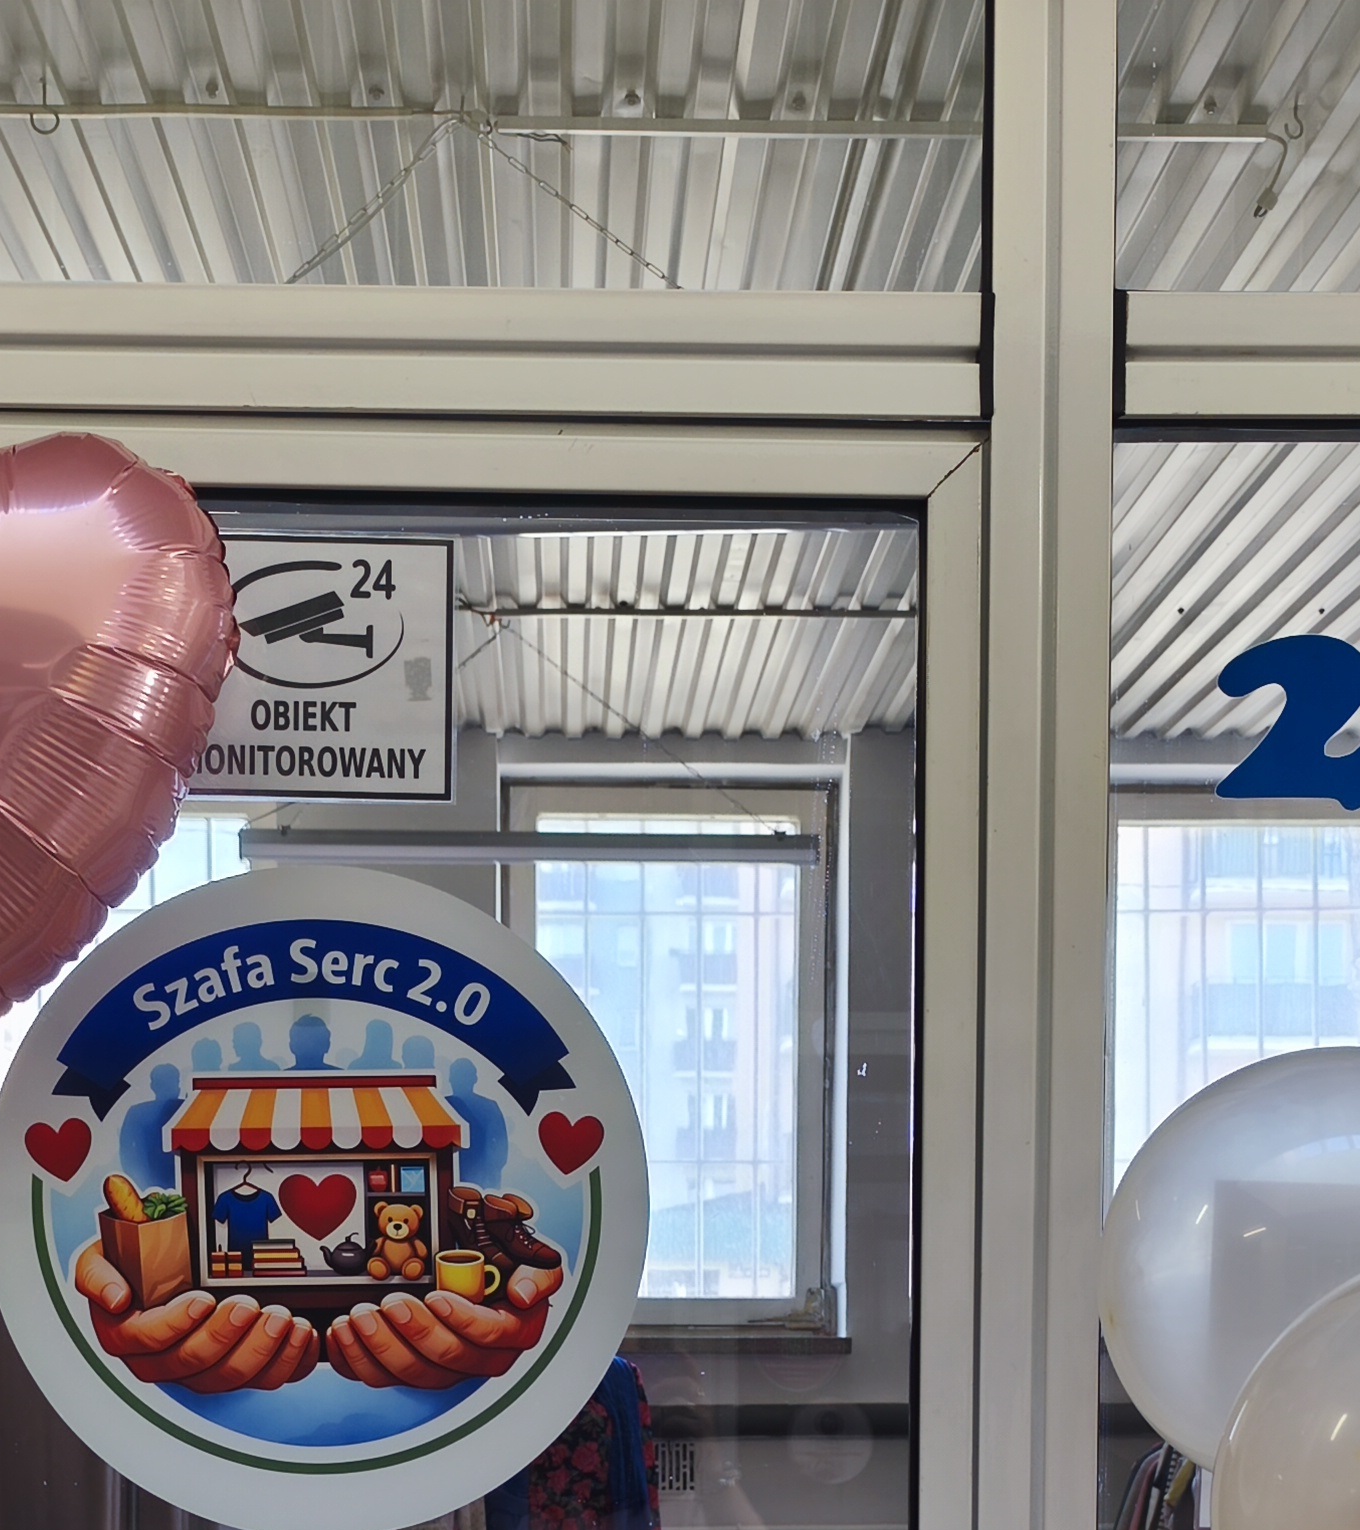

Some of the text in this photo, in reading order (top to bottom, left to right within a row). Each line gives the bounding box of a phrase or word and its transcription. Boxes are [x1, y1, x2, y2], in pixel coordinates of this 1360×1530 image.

[350, 559, 396, 600] 24
[251, 699, 357, 733] OBIEKT
[132, 937, 492, 1031] Szafa Serc 2.0
